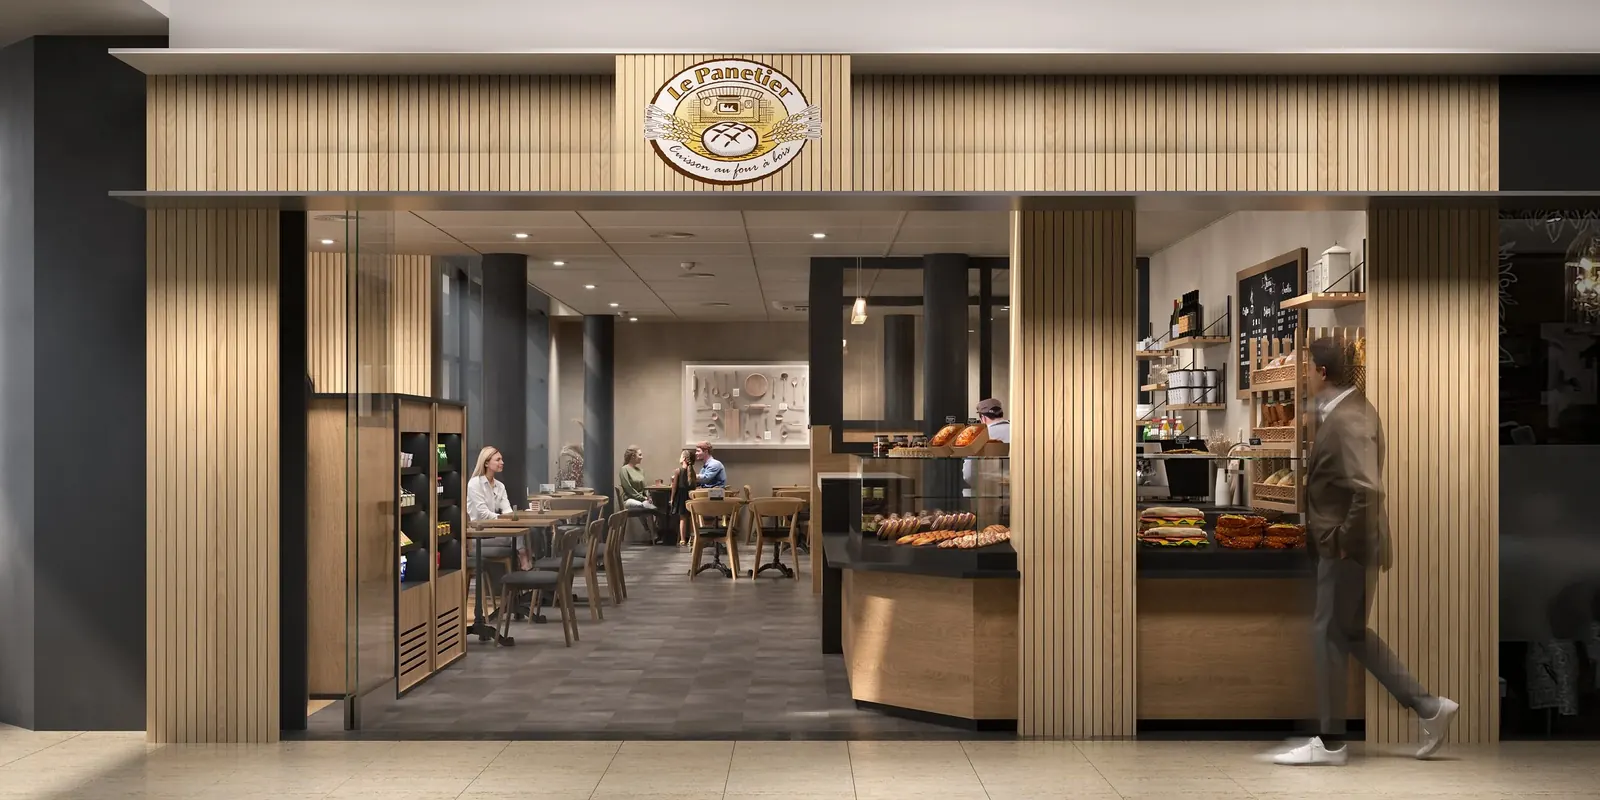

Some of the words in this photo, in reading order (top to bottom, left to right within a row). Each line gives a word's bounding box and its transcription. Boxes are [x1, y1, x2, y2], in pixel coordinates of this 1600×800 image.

[667, 79, 694, 101] Le
[694, 67, 793, 98] Panetier
[669, 145, 710, 171] Cuisson
[732, 163, 759, 180] four
[762, 158, 770, 168] à
[772, 146, 791, 163] bois
